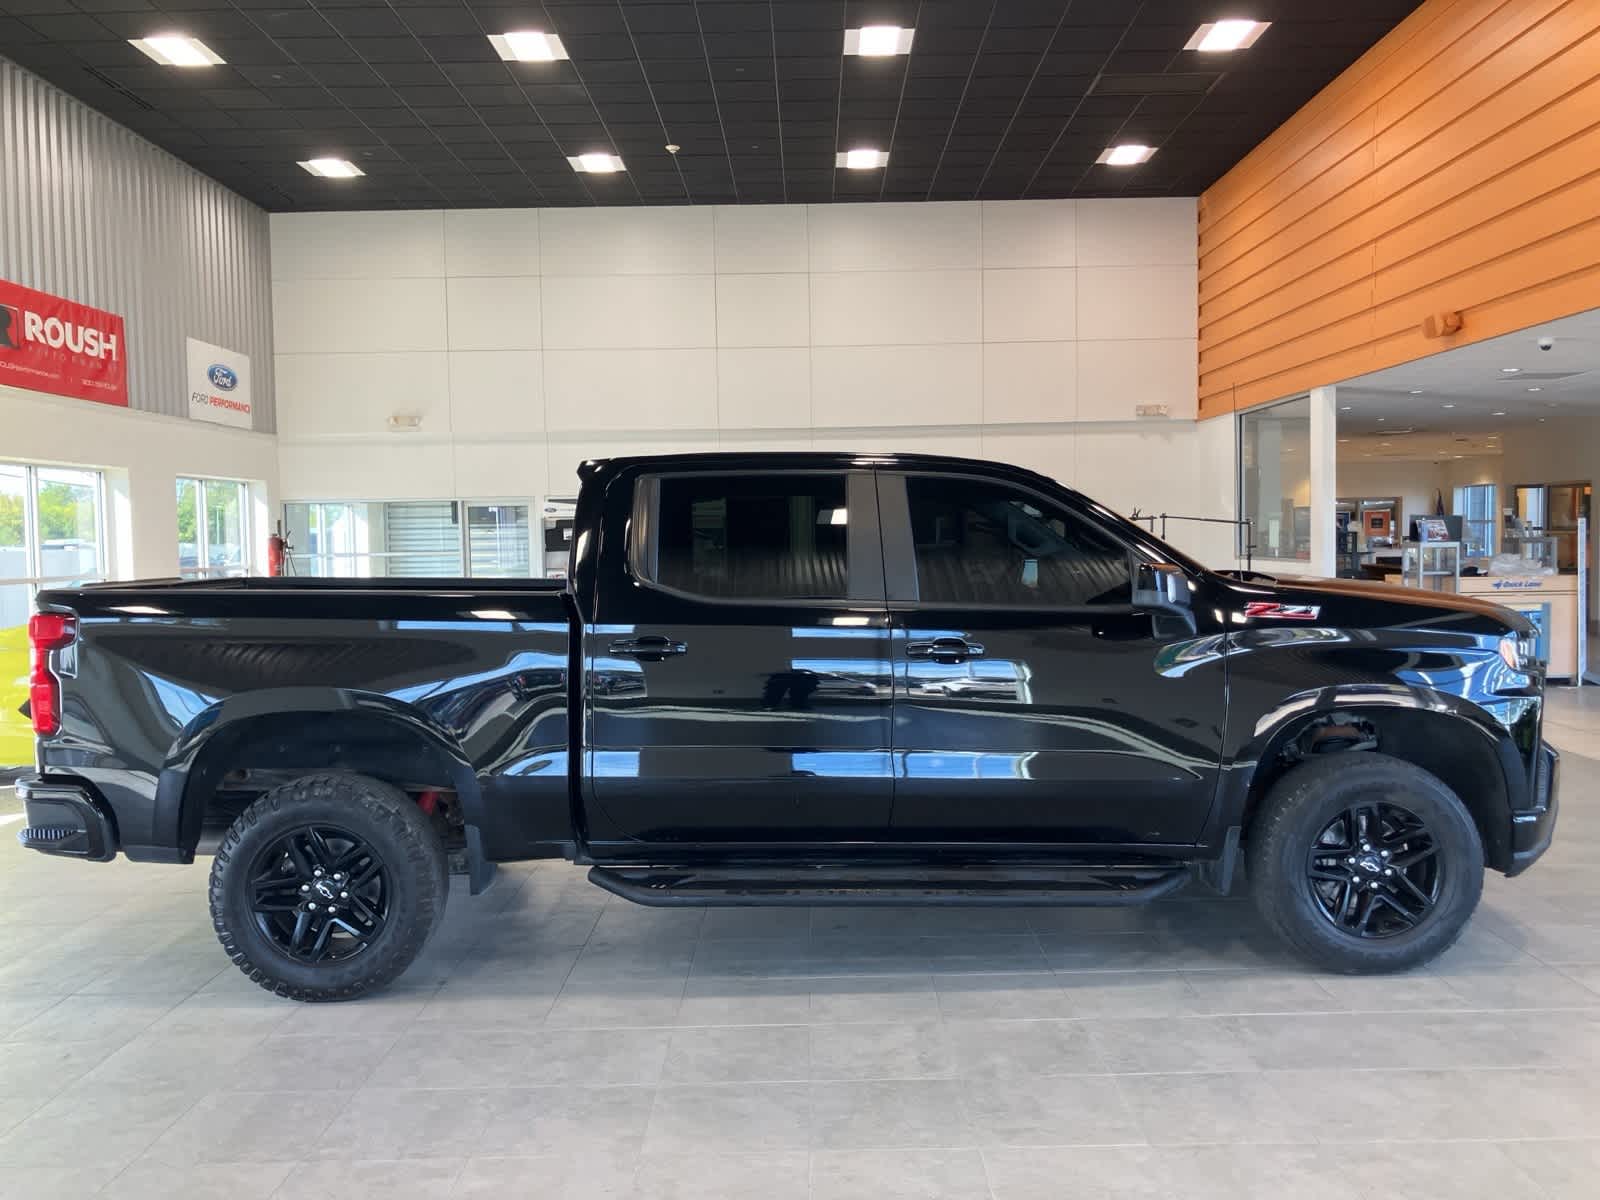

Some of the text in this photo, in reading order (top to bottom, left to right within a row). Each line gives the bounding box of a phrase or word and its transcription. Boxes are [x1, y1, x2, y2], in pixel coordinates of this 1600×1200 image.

[24, 310, 117, 361] ROUSH
[212, 367, 234, 388] Ford
[191, 391, 209, 405] FORD
[1244, 602, 1321, 620] Z71
